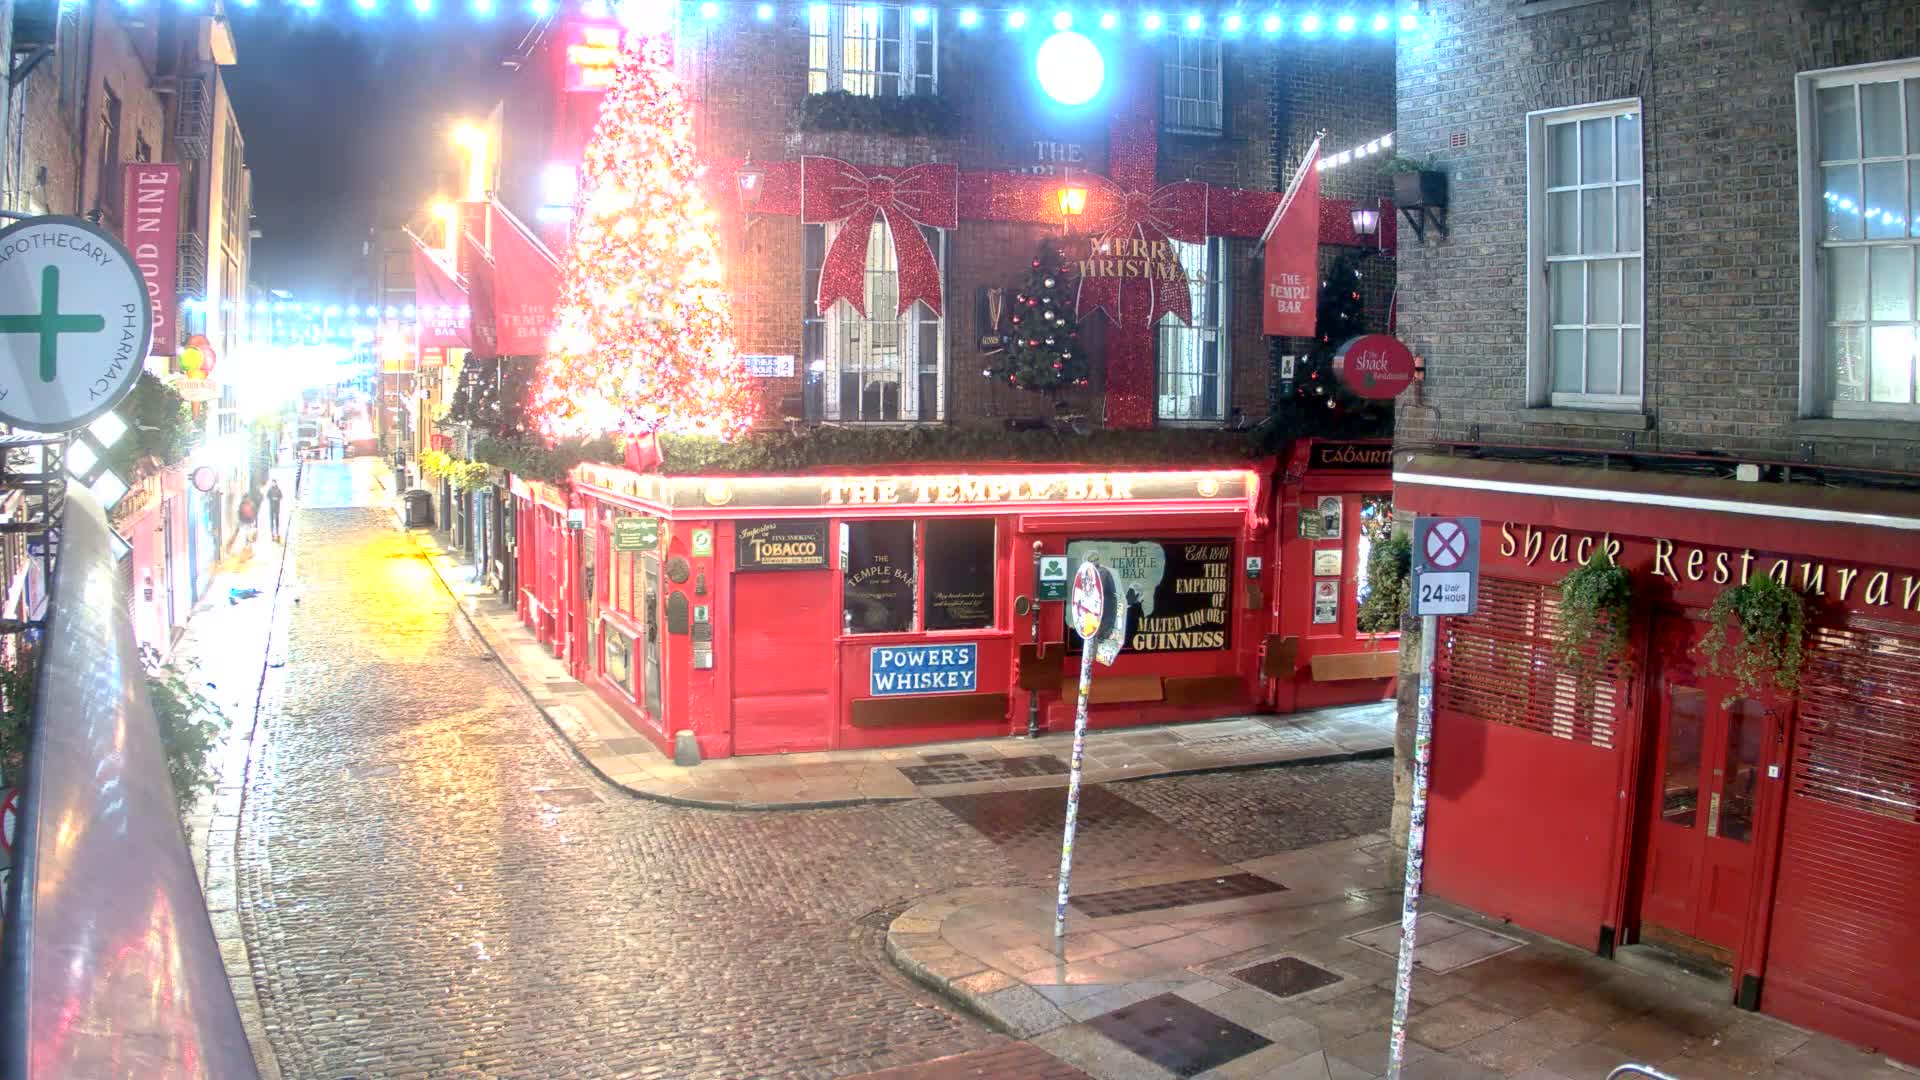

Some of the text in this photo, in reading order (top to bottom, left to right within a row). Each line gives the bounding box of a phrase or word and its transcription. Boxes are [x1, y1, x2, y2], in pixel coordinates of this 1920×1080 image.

[1033, 142, 1083, 162] THE
[137, 172, 169, 233] NINE
[1089, 237, 1181, 262] MERRY
[1281, 273, 1304, 285] THE
[1278, 300, 1304, 313] BAR
[88, 303, 136, 401] PHARMACY
[823, 472, 1133, 504] THE TEMPLE BAR
[750, 539, 817, 562] TOBACCO
[1121, 547, 1147, 558] THE
[1501, 520, 1621, 568] Shack
[1110, 557, 1158, 569] TEMPLE
[1203, 563, 1227, 578] THE
[847, 566, 915, 588] TEMPLE BAR
[1120, 568, 1146, 579] BAR
[1175, 578, 1227, 594] EMPEROR
[1422, 584, 1443, 603] 24
[1212, 593, 1226, 608] OF
[1444, 594, 1466, 602] HOUR
[1138, 608, 1227, 633] MALTED LIQUORS
[1132, 631, 1225, 651] GUINNESS
[880, 647, 970, 668] POWER'S
[873, 670, 974, 690] WHISKEY
